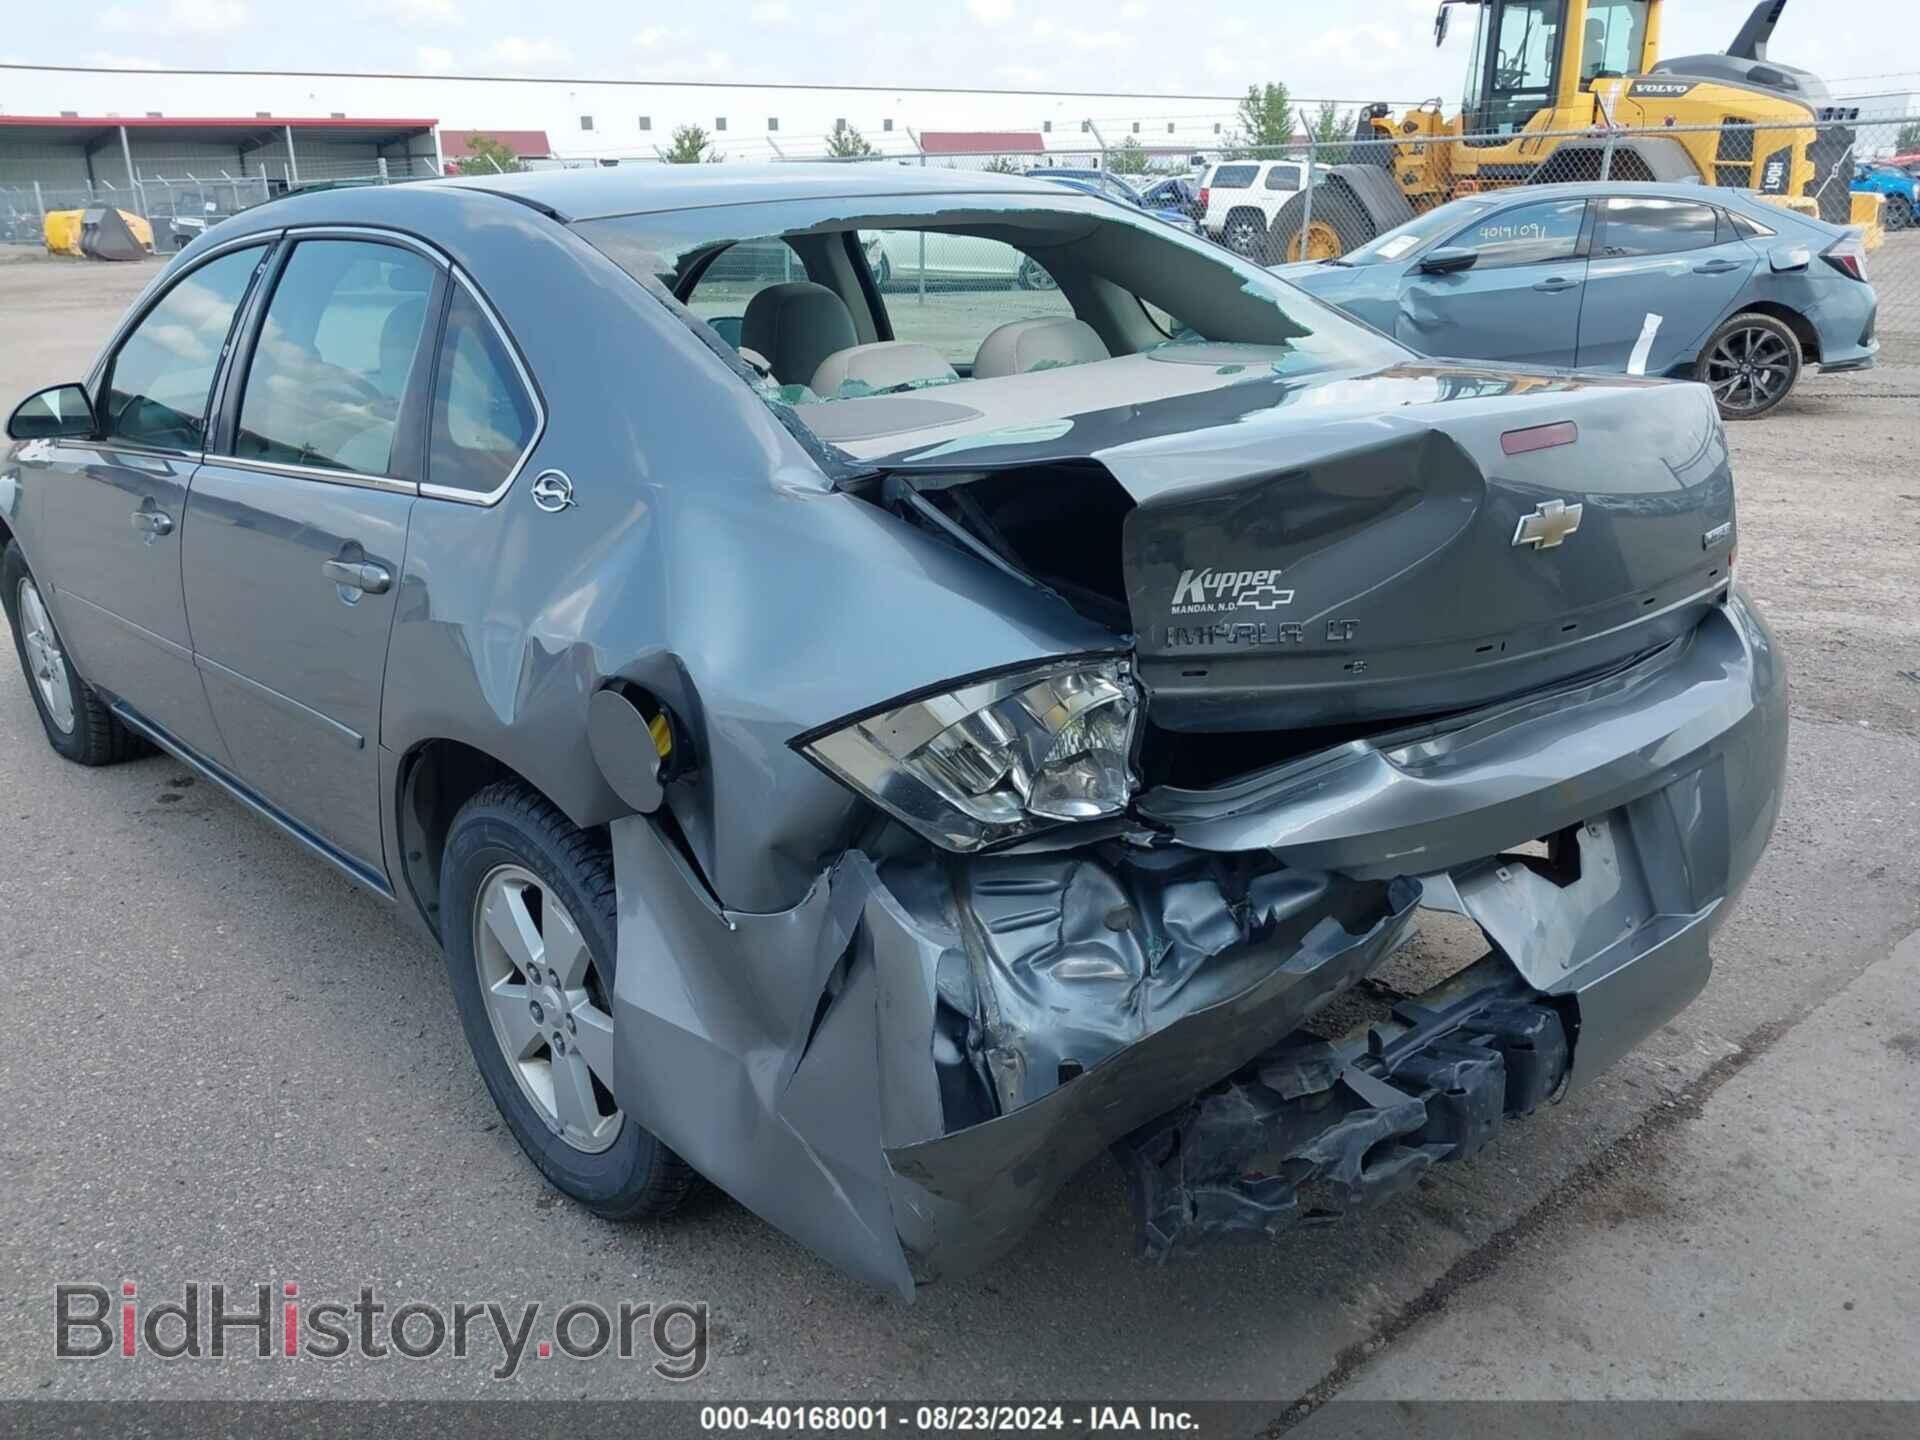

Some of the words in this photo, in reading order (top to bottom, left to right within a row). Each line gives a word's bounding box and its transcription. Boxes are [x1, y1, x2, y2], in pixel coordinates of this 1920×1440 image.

[1636, 84, 1688, 93] VOLVO
[1764, 162, 1785, 189] L90H
[1171, 567, 1282, 605] Kupper
[1171, 604, 1216, 615] MANDAN,
[1218, 602, 1238, 612] N.D.
[1327, 618, 1361, 641] LT
